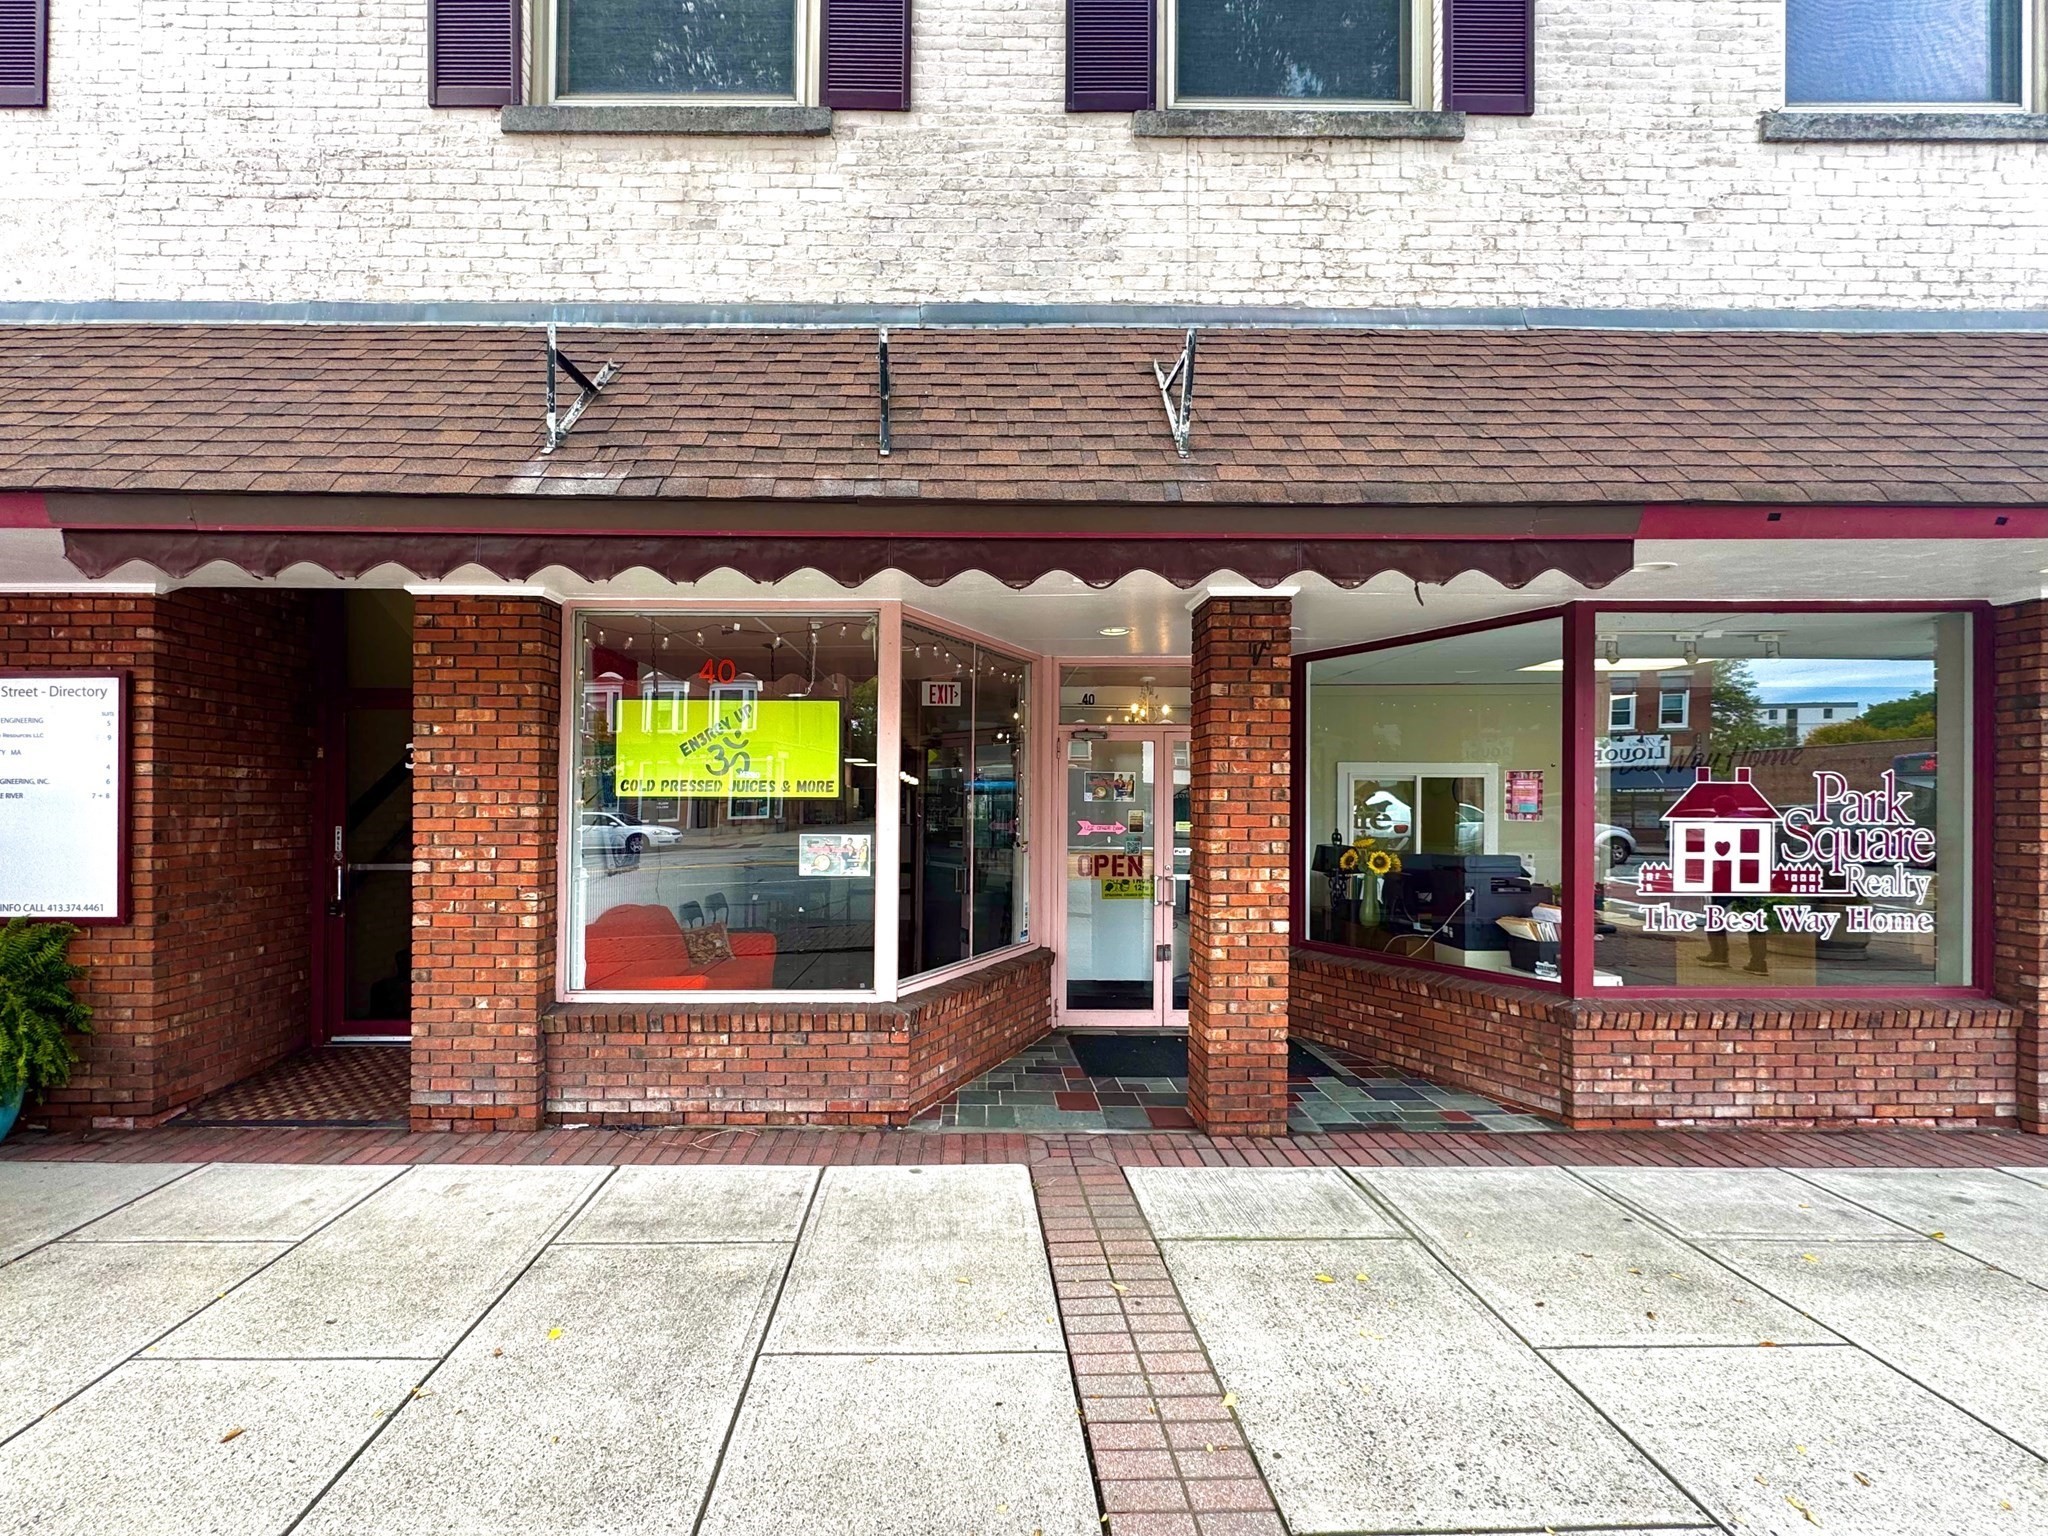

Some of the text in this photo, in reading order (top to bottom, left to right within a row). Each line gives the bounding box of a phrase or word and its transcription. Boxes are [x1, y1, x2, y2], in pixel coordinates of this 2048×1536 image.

[699, 658, 736, 684] 40
[1, 685, 39, 698] Street
[49, 685, 108, 700] Directory
[929, 684, 956, 704] EXIT
[1081, 693, 1096, 706] 40
[733, 703, 753, 723] UP
[620, 779, 835, 793] COLD PRESSED JUICES & MORE
[1813, 768, 1915, 826] Park
[1781, 807, 1936, 876] Square
[1077, 854, 1143, 877] OPEN
[1844, 863, 1931, 905] Realty
[0, 903, 104, 912] INFO CALL 413.374.4461
[1639, 902, 1934, 940] The Best Way Home
